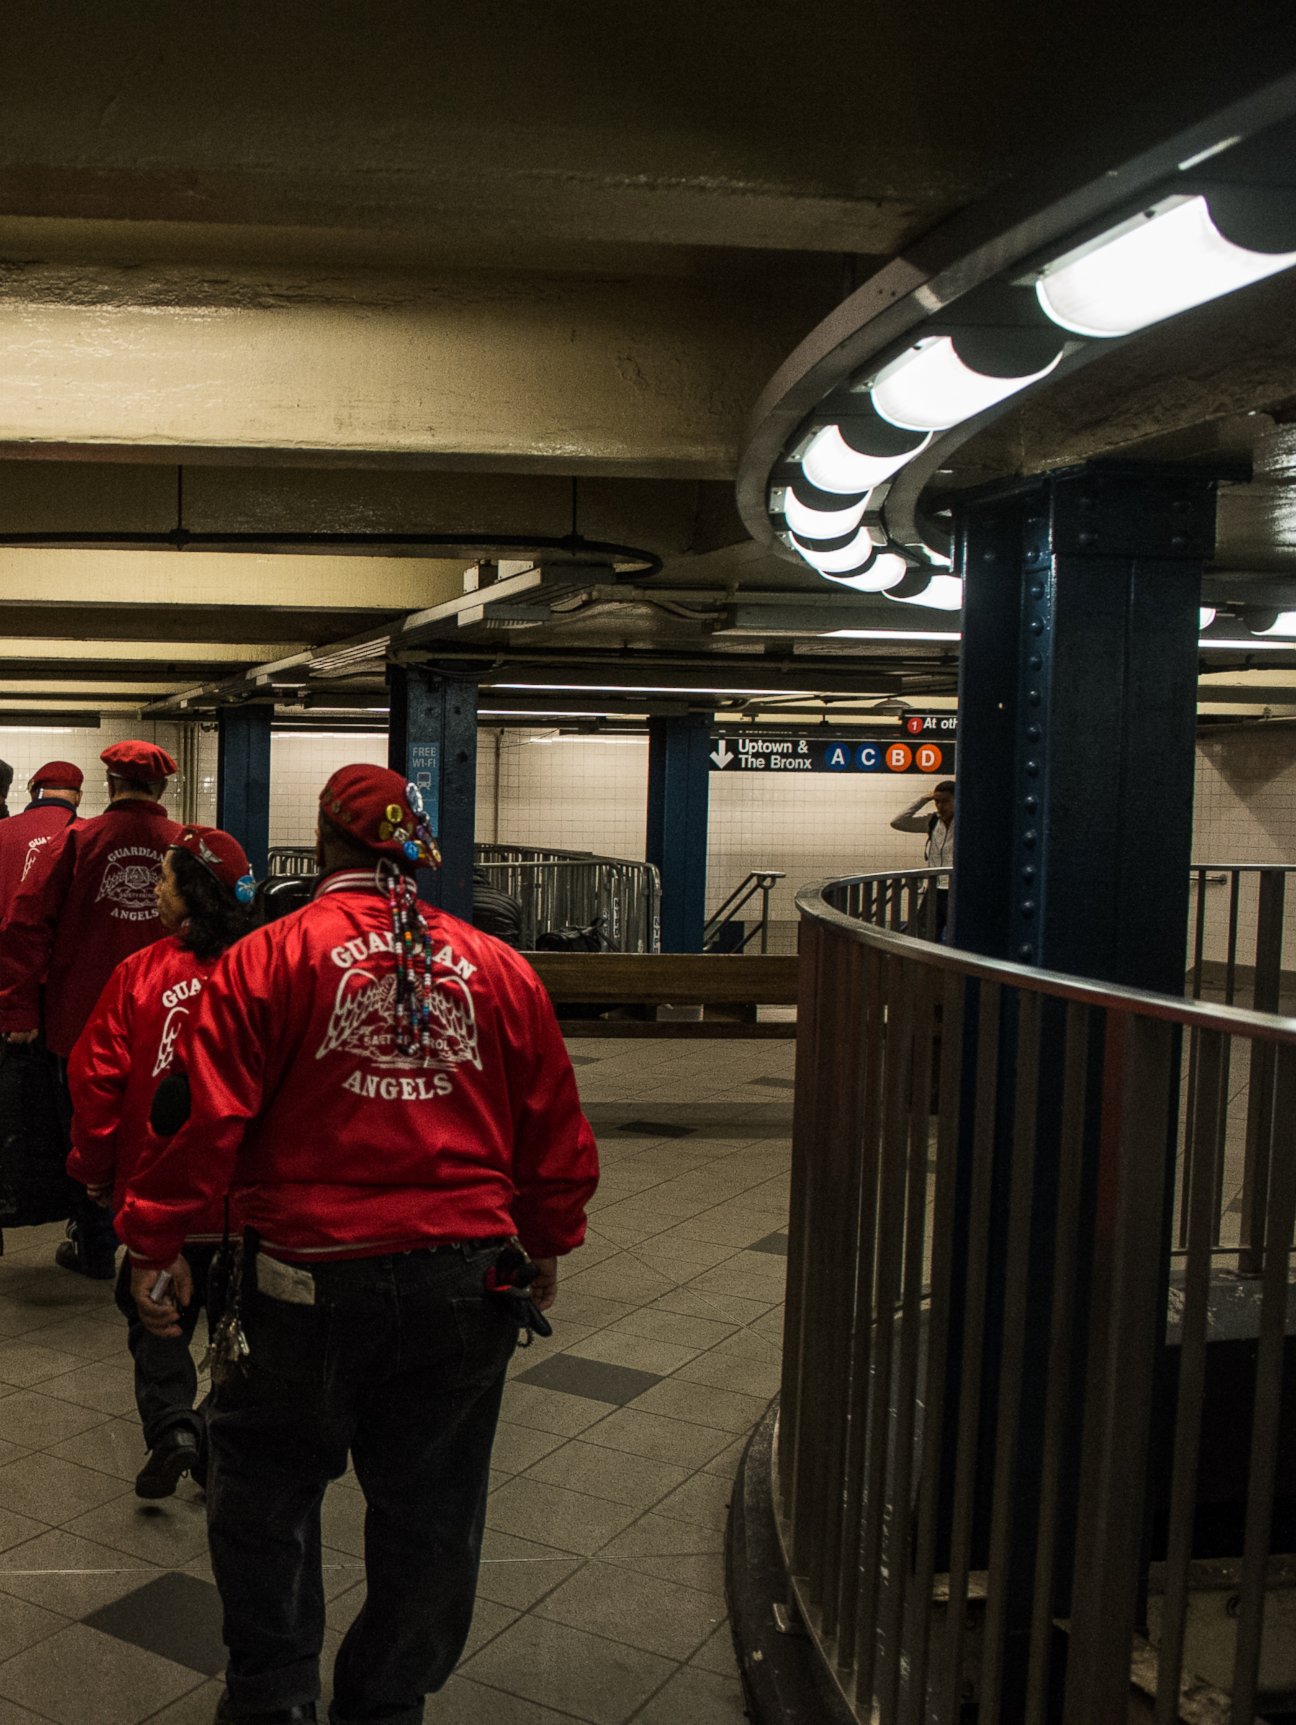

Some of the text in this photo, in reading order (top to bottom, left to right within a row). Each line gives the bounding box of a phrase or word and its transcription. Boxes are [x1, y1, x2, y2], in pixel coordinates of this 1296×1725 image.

[911, 720, 918, 731] 1
[923, 717, 937, 729] At
[412, 747, 437, 757] FREE
[738, 739, 809, 755] Uptown &
[412, 758, 436, 768] WI-FI
[738, 755, 812, 769] The Bronx
[830, 748, 936, 767] A C B D
[110, 907, 160, 922] ANGELS
[330, 931, 478, 981] GUAAN
[341, 1069, 454, 1101] ANGELS
